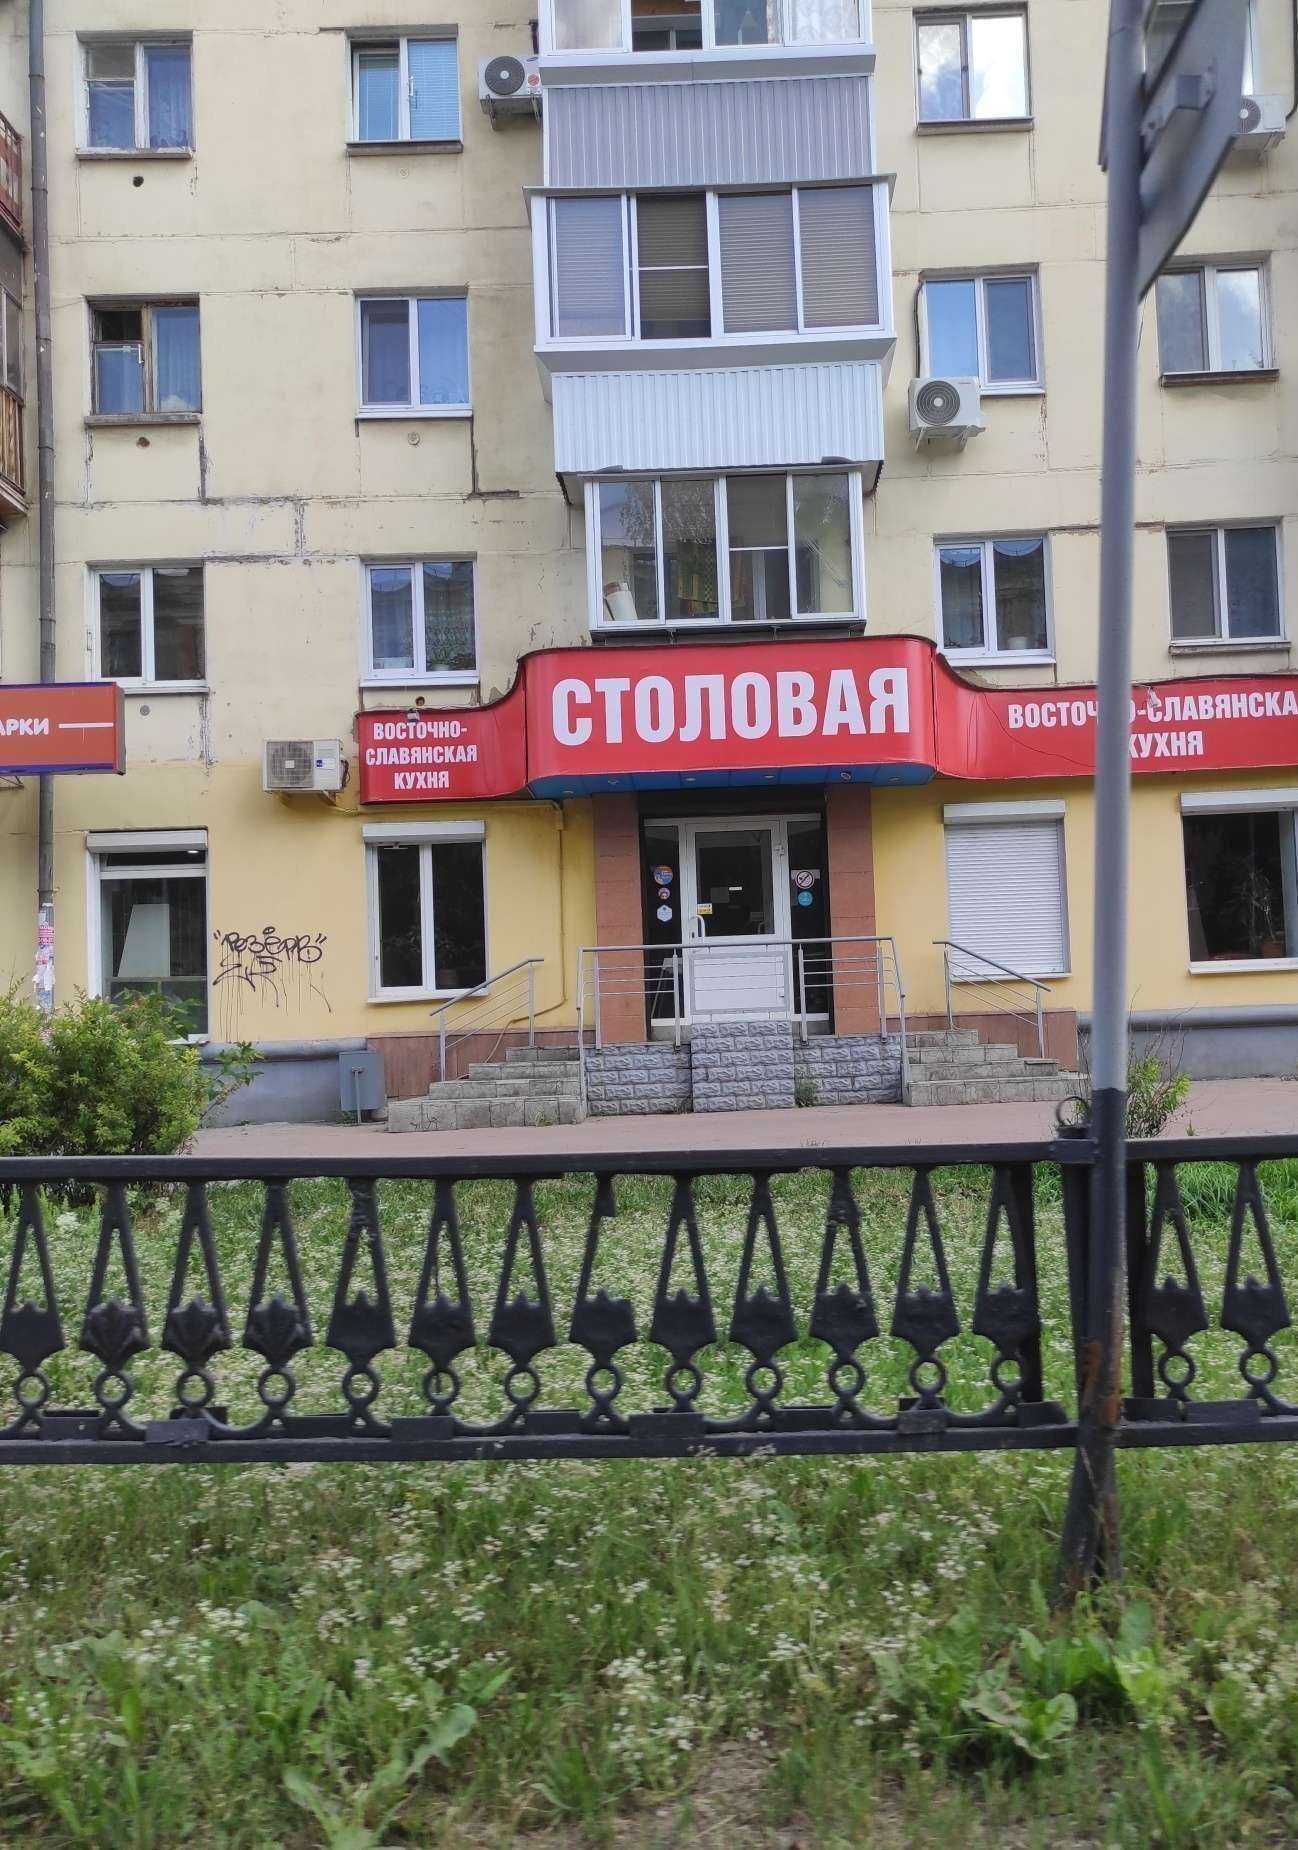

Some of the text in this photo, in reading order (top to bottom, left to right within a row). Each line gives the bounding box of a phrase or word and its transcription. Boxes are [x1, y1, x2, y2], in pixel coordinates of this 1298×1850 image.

[552, 667, 910, 746] СТОЛОВАЯ
[1007, 690, 1298, 729] ВОСТОЧ-СЛАВЯНСКА
[373, 720, 468, 740] ВОСТОЧНО-
[365, 744, 478, 766] СЛАВЯНСКАЯ
[394, 770, 450, 790] КУХНЯ
